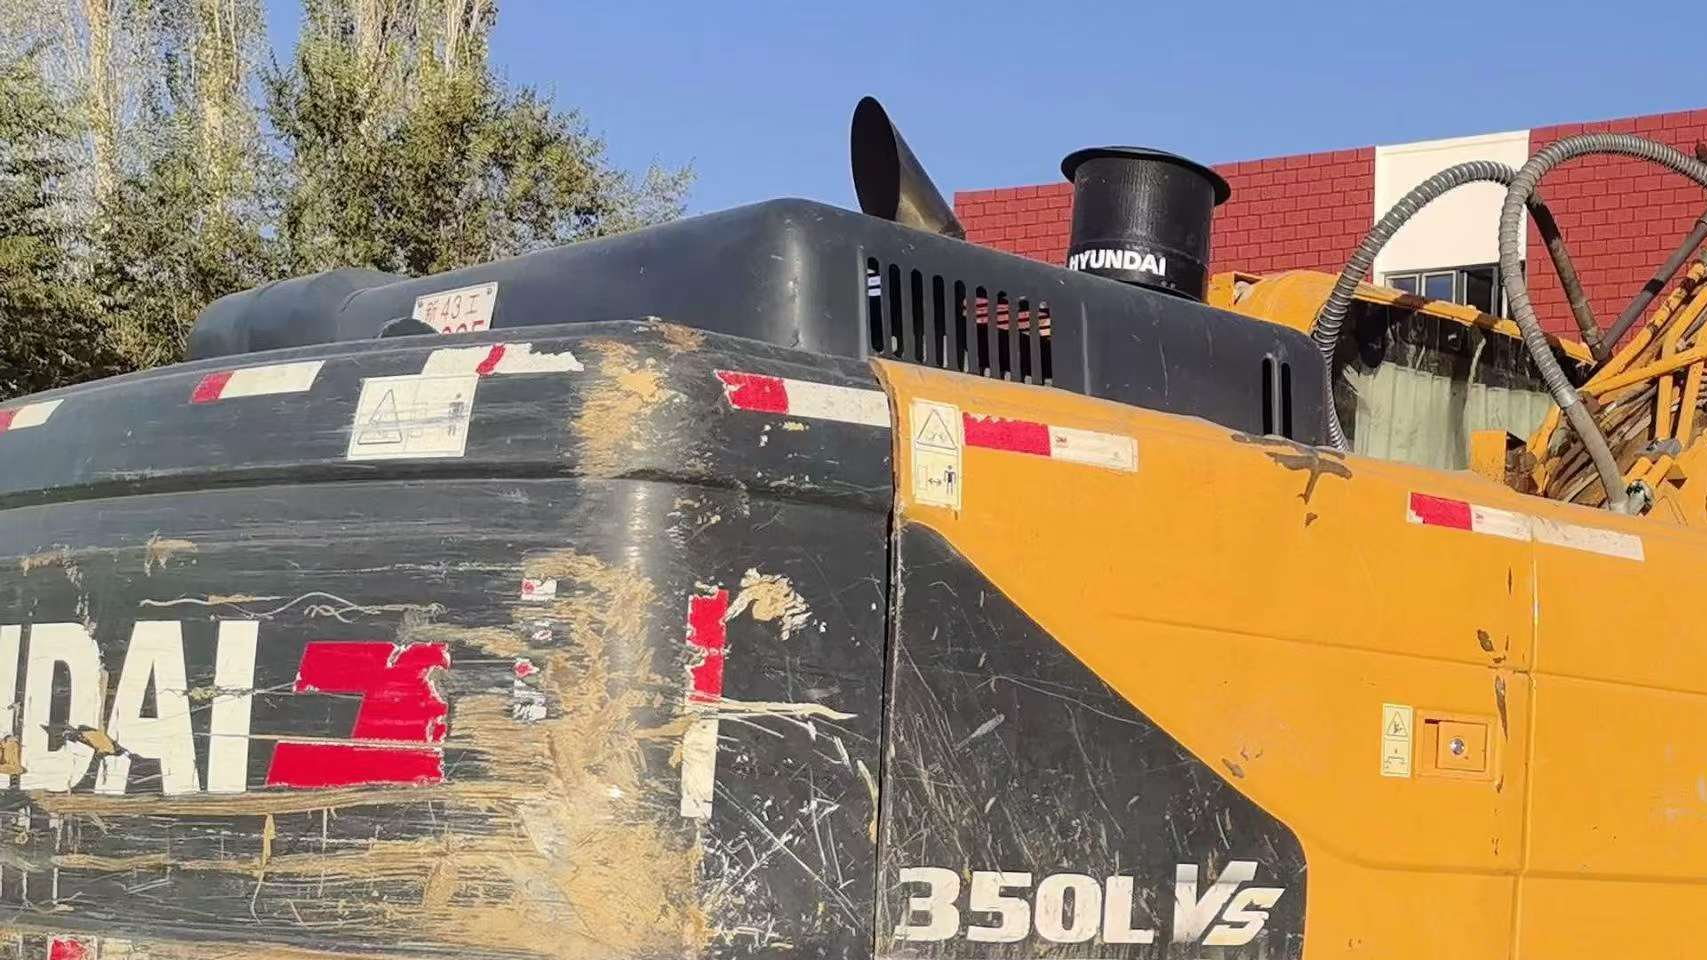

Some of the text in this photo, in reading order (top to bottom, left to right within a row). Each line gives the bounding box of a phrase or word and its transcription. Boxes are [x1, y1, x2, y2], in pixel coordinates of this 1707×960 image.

[1069, 249, 1167, 276] HYUNDAI
[0, 620, 260, 796] DAI
[895, 866, 1154, 944] 350L
